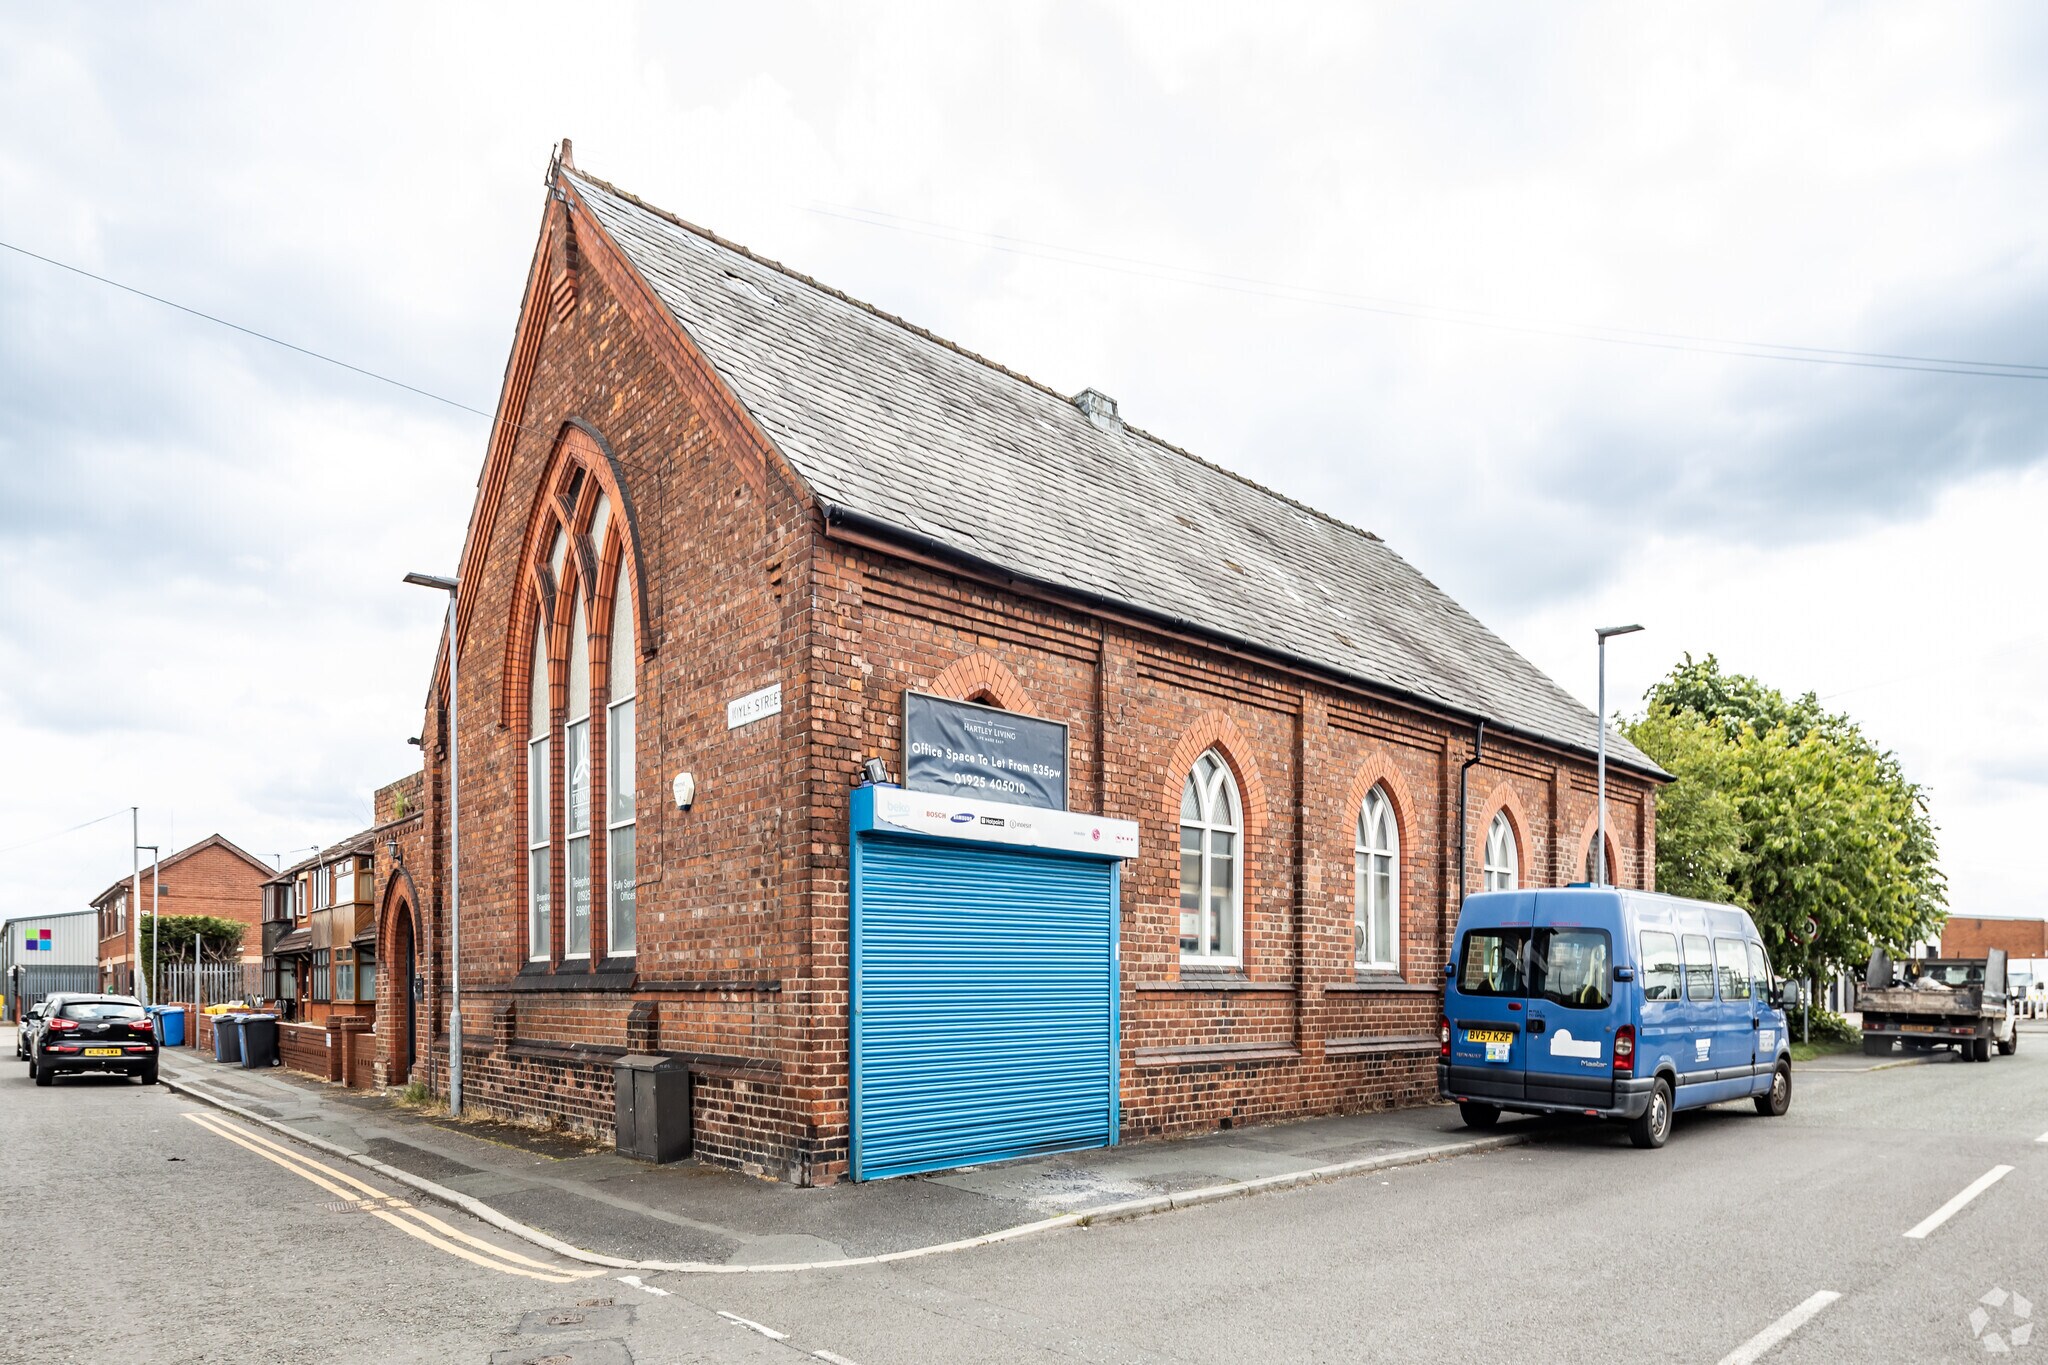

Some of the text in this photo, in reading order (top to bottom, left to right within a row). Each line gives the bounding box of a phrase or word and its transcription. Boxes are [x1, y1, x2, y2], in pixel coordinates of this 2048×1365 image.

[964, 722, 1016, 740] HARTLEY LIVING
[912, 743, 1061, 779] Office Space To Let From £35pw
[954, 773, 1026, 794] 01925 405010
[887, 800, 910, 812] beko
[926, 811, 947, 819] BOSCH
[985, 817, 1004, 826] Hotpoint
[613, 880, 623, 891] Fully
[620, 891, 636, 902] Offices
[1469, 1030, 1511, 1042] BV57 KZF
[1580, 1060, 1608, 1068] Master
